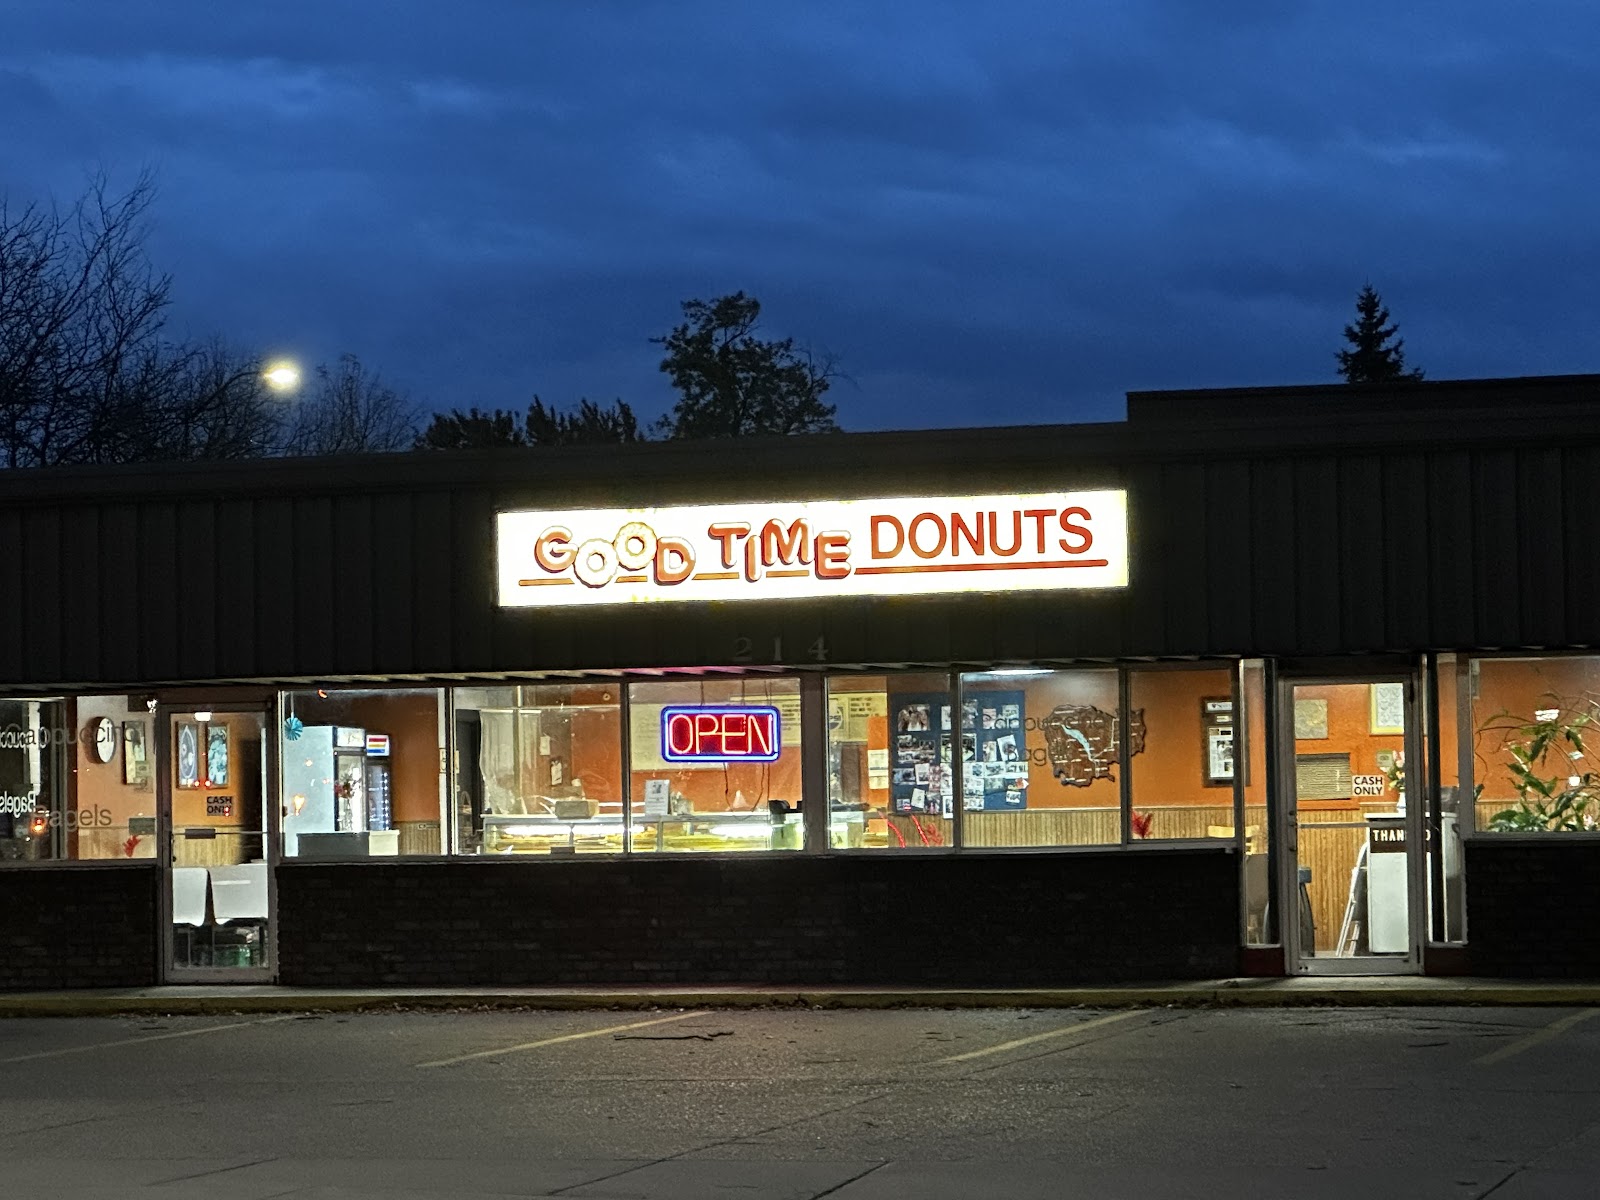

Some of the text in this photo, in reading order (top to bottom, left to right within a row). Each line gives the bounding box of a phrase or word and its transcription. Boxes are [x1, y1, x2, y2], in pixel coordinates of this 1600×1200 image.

[534, 507, 1093, 588] GOOD TIME DONUTS
[668, 713, 773, 755] OPEN
[1354, 776, 1383, 785] CASH
[1354, 786, 1382, 795] ONLY
[207, 796, 232, 804] CASH
[1372, 829, 1407, 842] THAN
